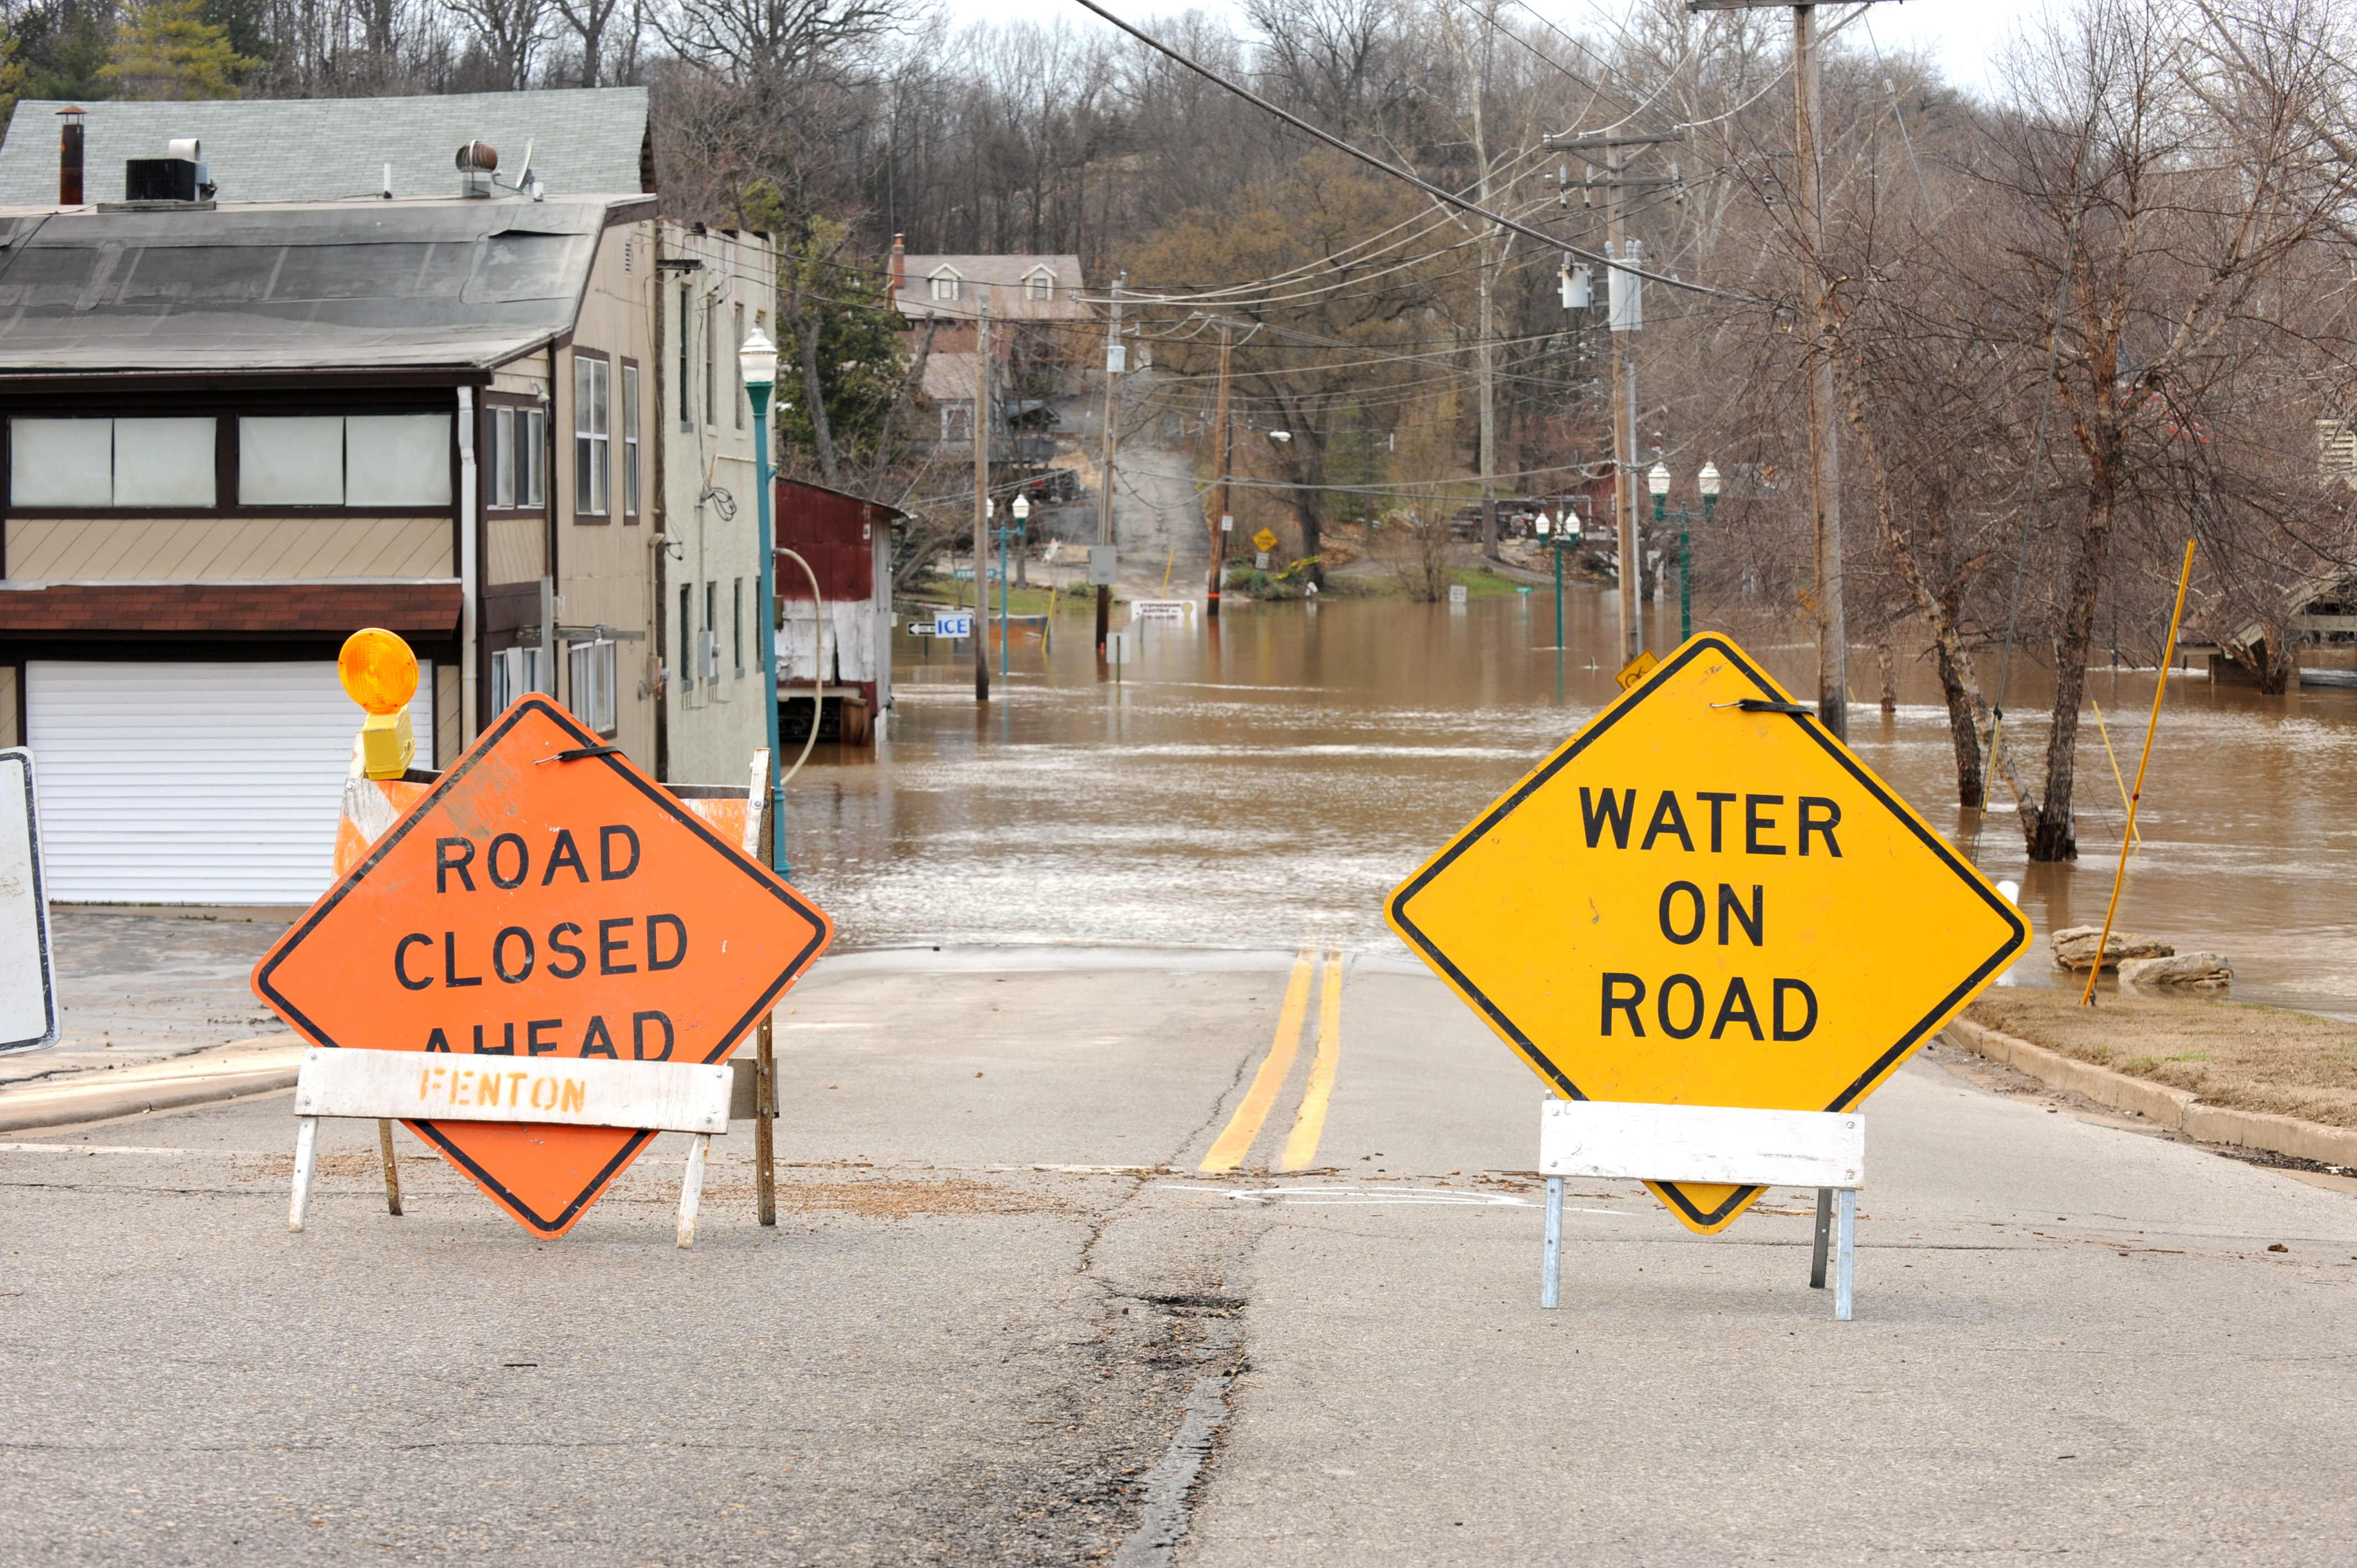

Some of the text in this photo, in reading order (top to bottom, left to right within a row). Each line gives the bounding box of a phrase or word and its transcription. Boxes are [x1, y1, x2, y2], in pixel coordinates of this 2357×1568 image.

[938, 618, 967, 634] ICE
[1579, 786, 1843, 858] WATER
[436, 824, 641, 894] ROAD
[1659, 880, 1763, 947] ON
[394, 913, 688, 991] CLOSED
[1601, 972, 1819, 1042] ROAD
[419, 1067, 586, 1115] FENTON
